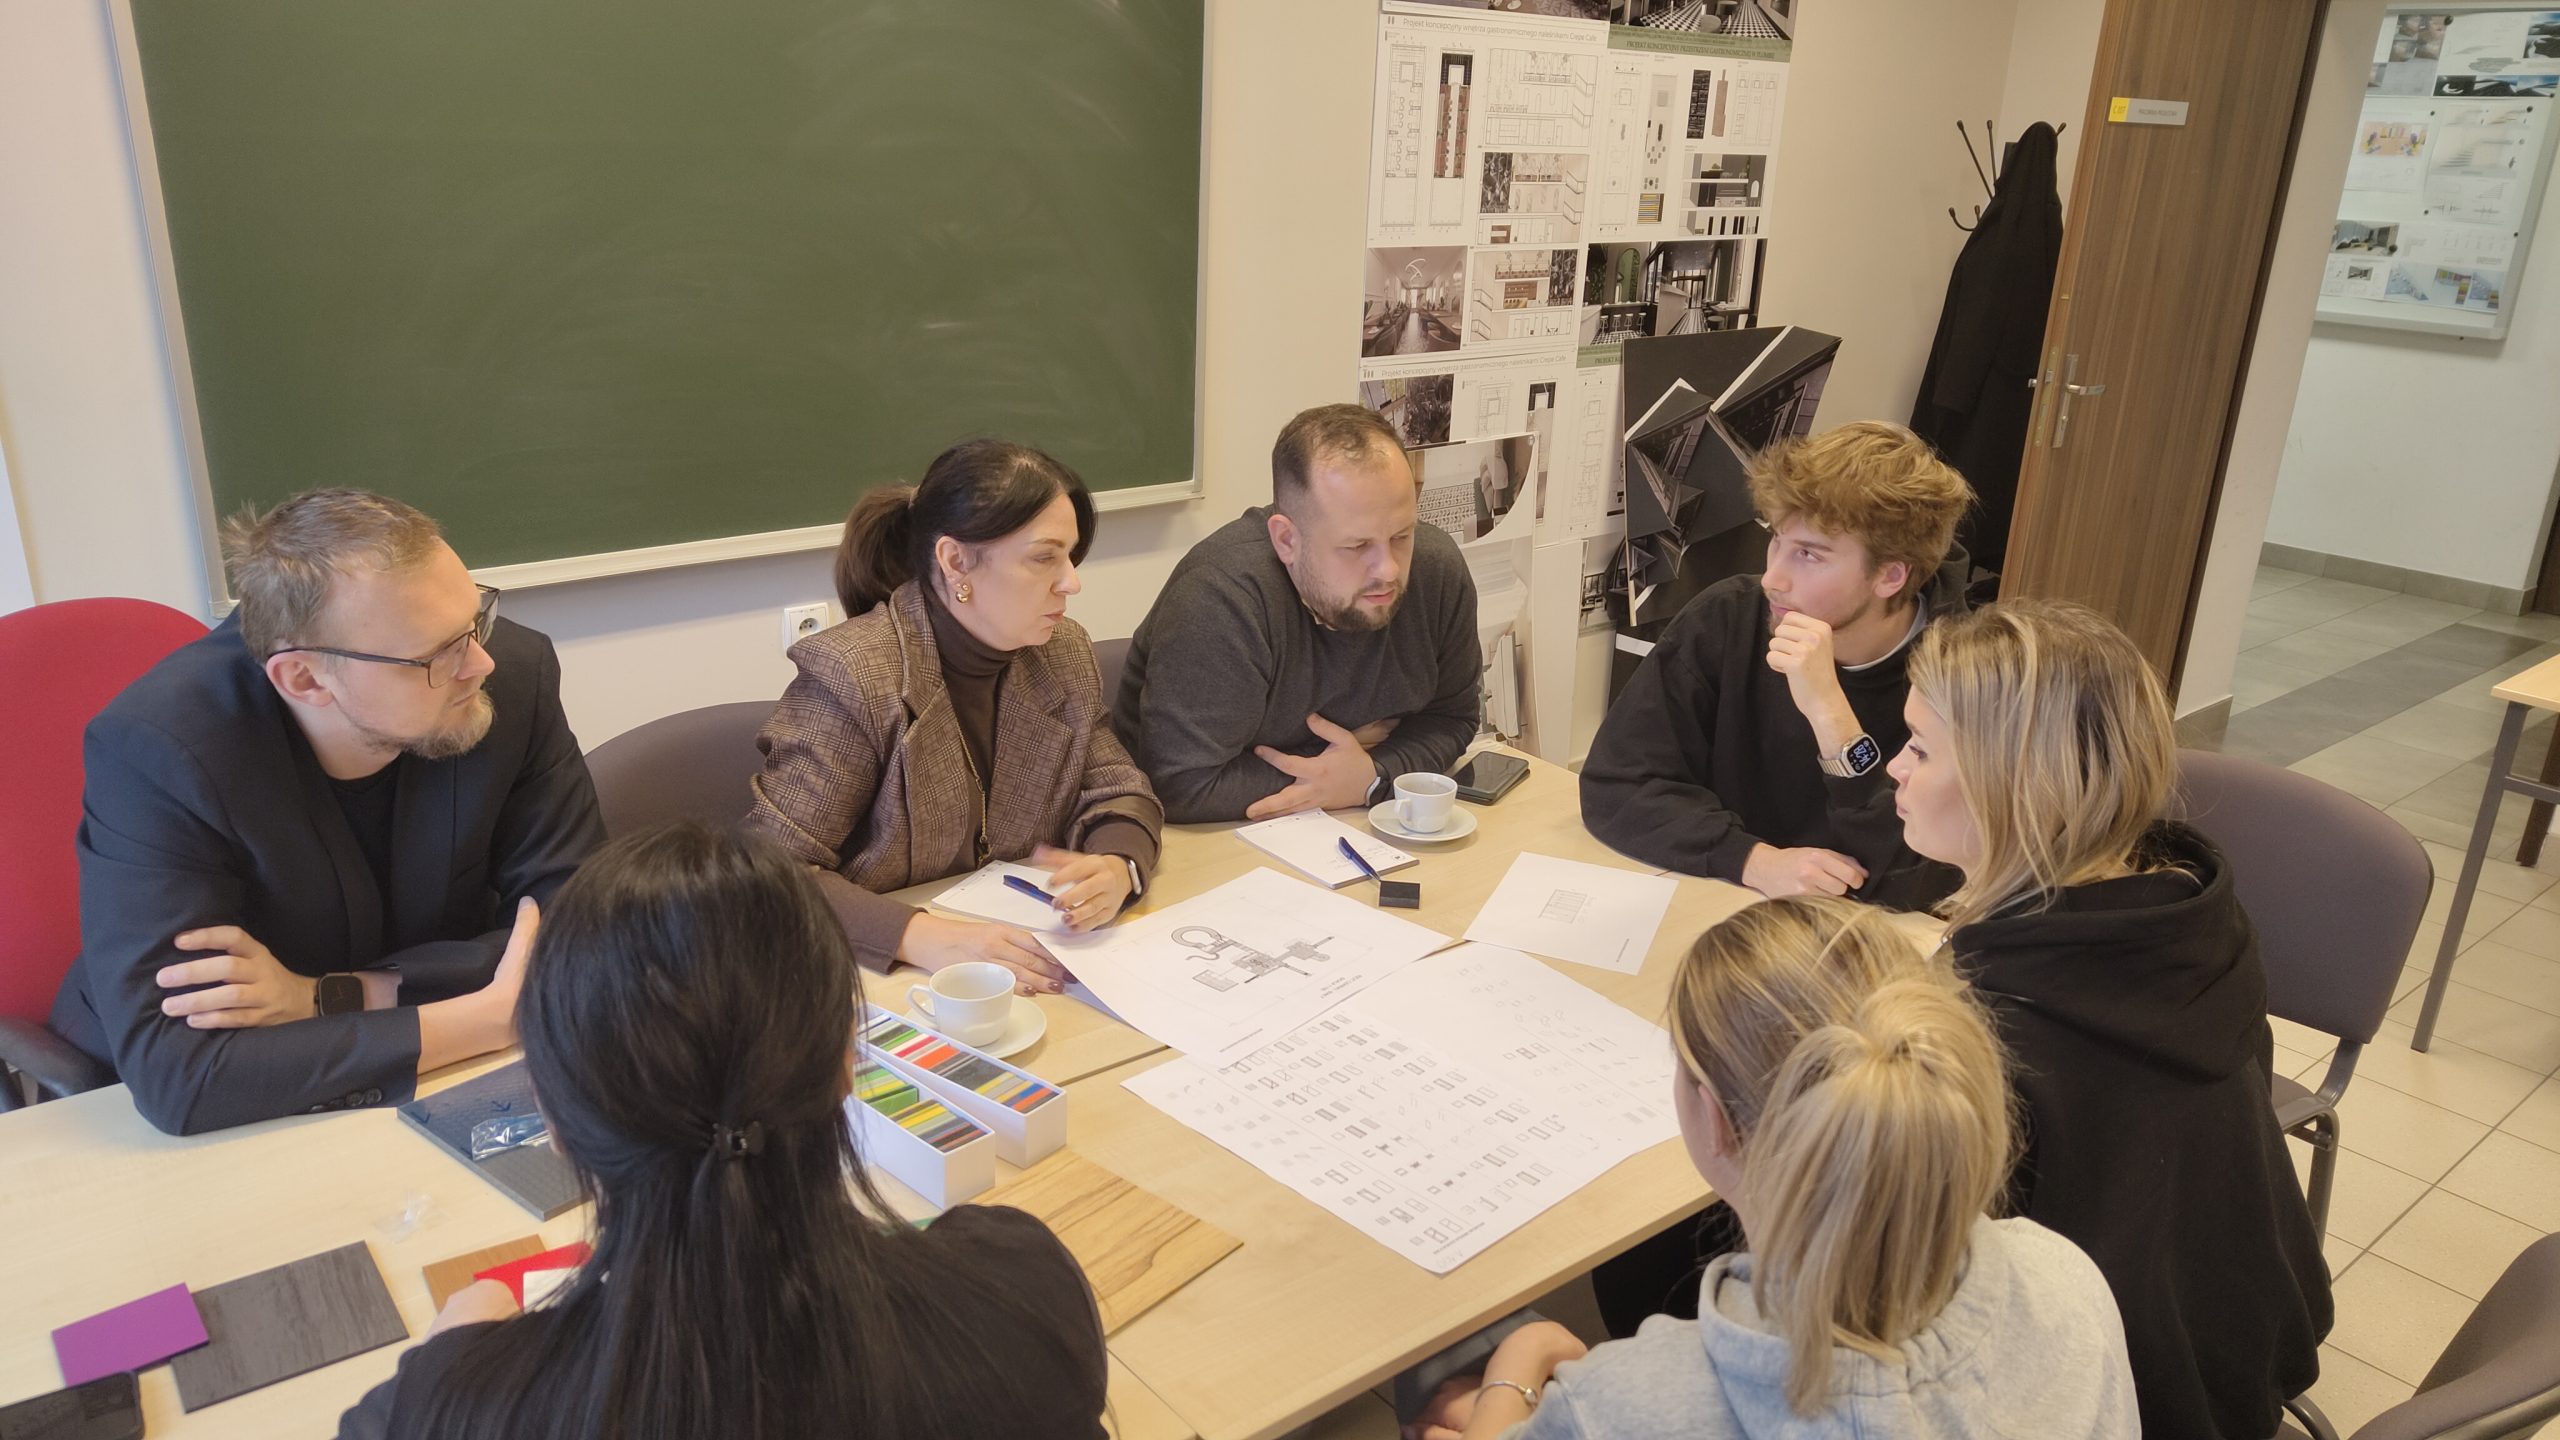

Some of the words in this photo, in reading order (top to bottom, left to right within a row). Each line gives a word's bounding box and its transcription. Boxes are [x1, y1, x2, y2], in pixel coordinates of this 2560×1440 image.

[1403, 18, 1424, 28] Projekt
[1425, 19, 1461, 31] koncepcyjny
[1381, 368, 1402, 377] Projekt
